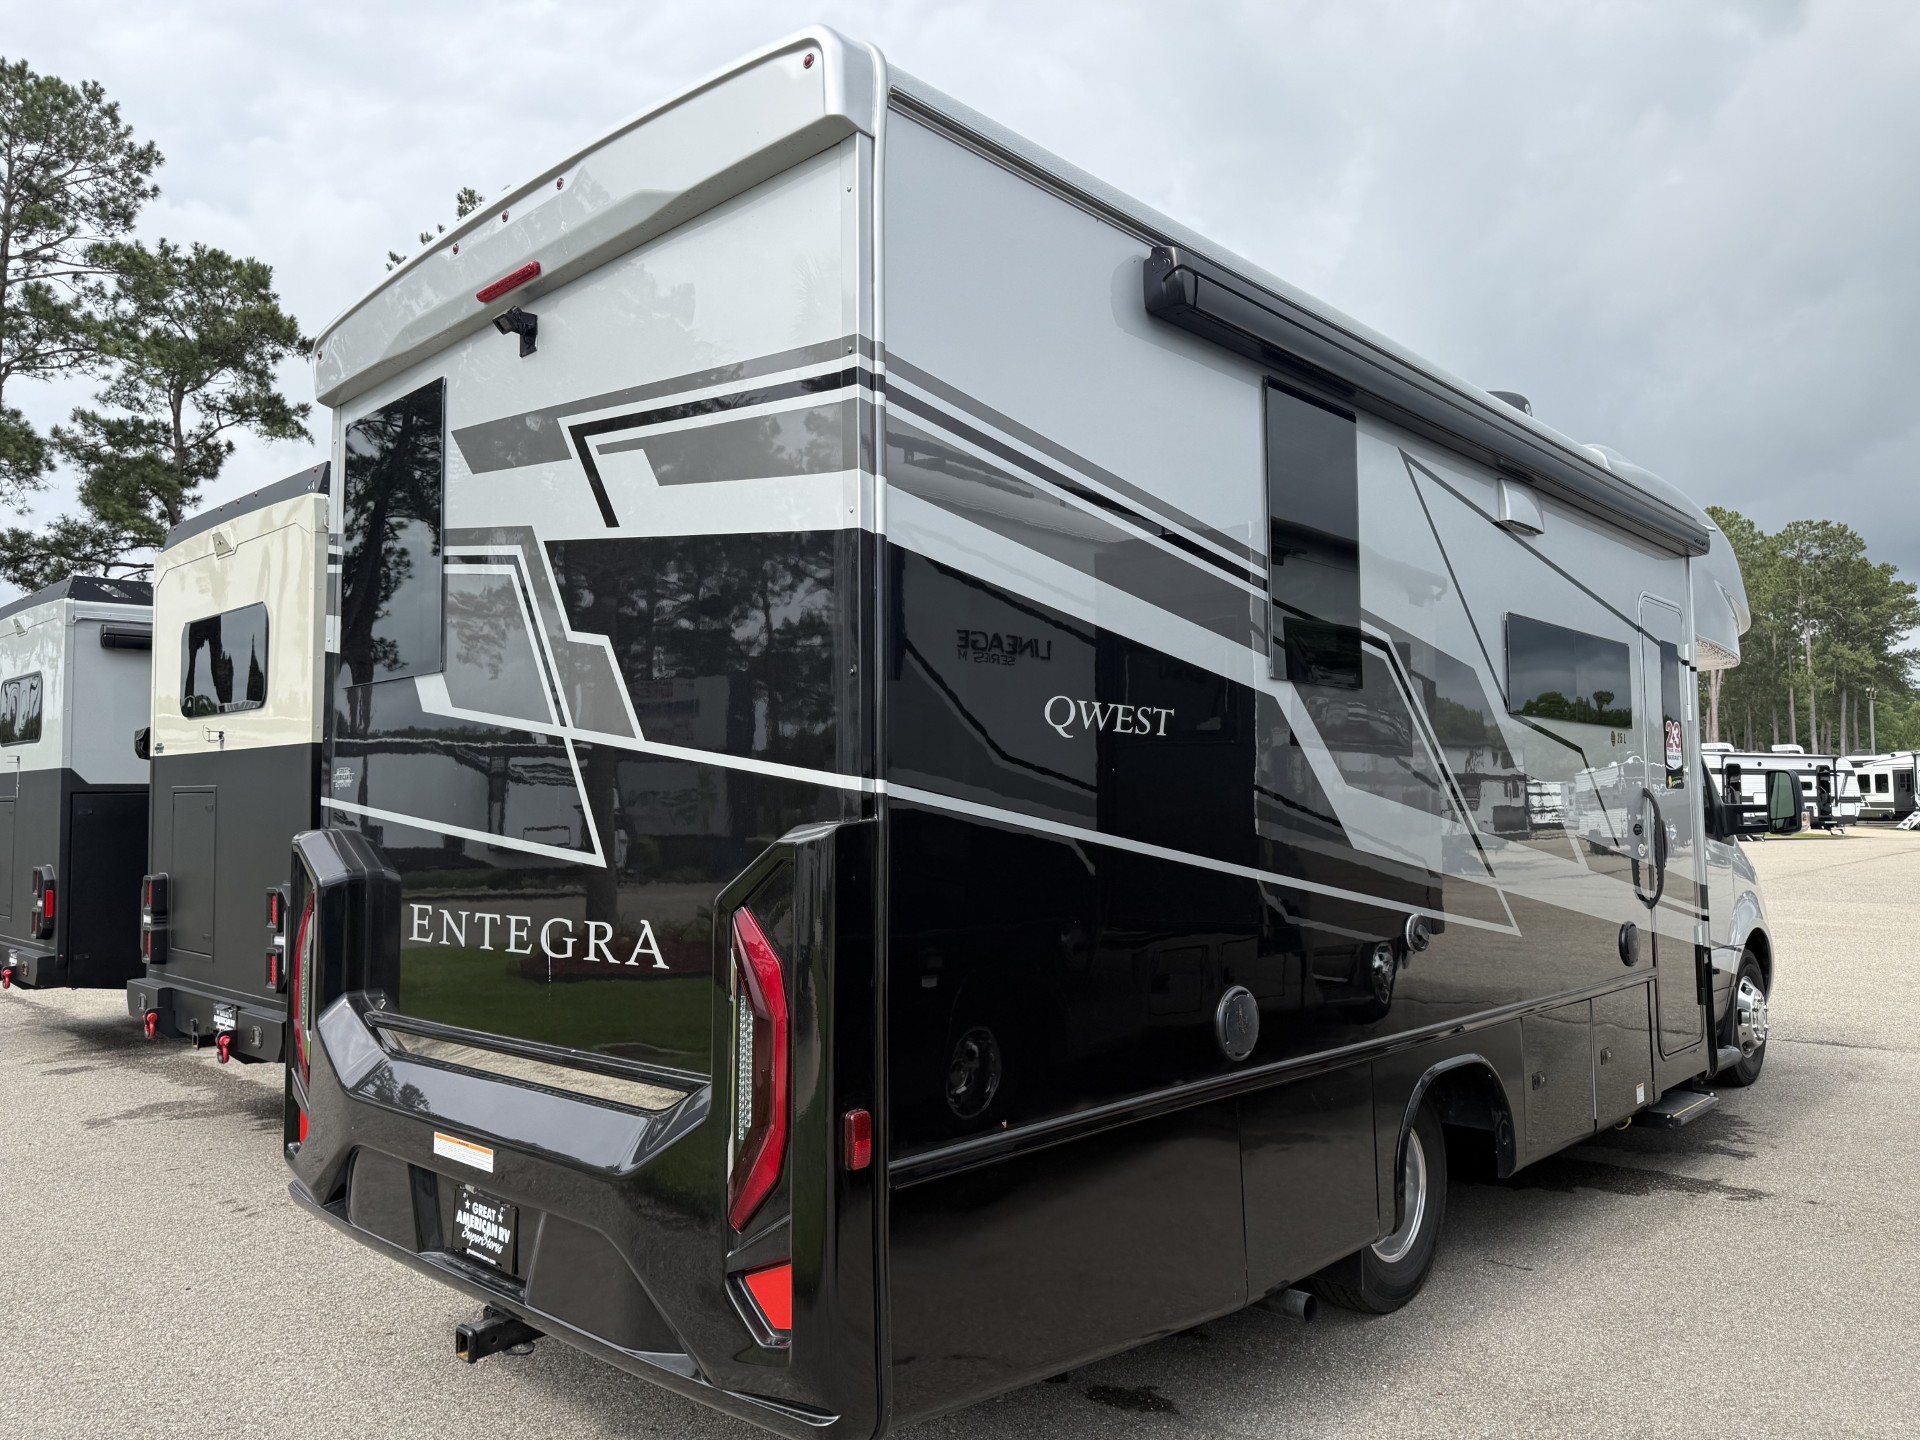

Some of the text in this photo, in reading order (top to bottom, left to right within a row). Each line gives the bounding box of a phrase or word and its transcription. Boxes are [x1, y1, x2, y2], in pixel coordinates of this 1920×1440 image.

[1044, 695, 1175, 739] QWEST
[409, 903, 670, 970] ENTEGRA
[456, 1209, 511, 1244] AMERICAN RV
[472, 1201, 497, 1222] GREAT
